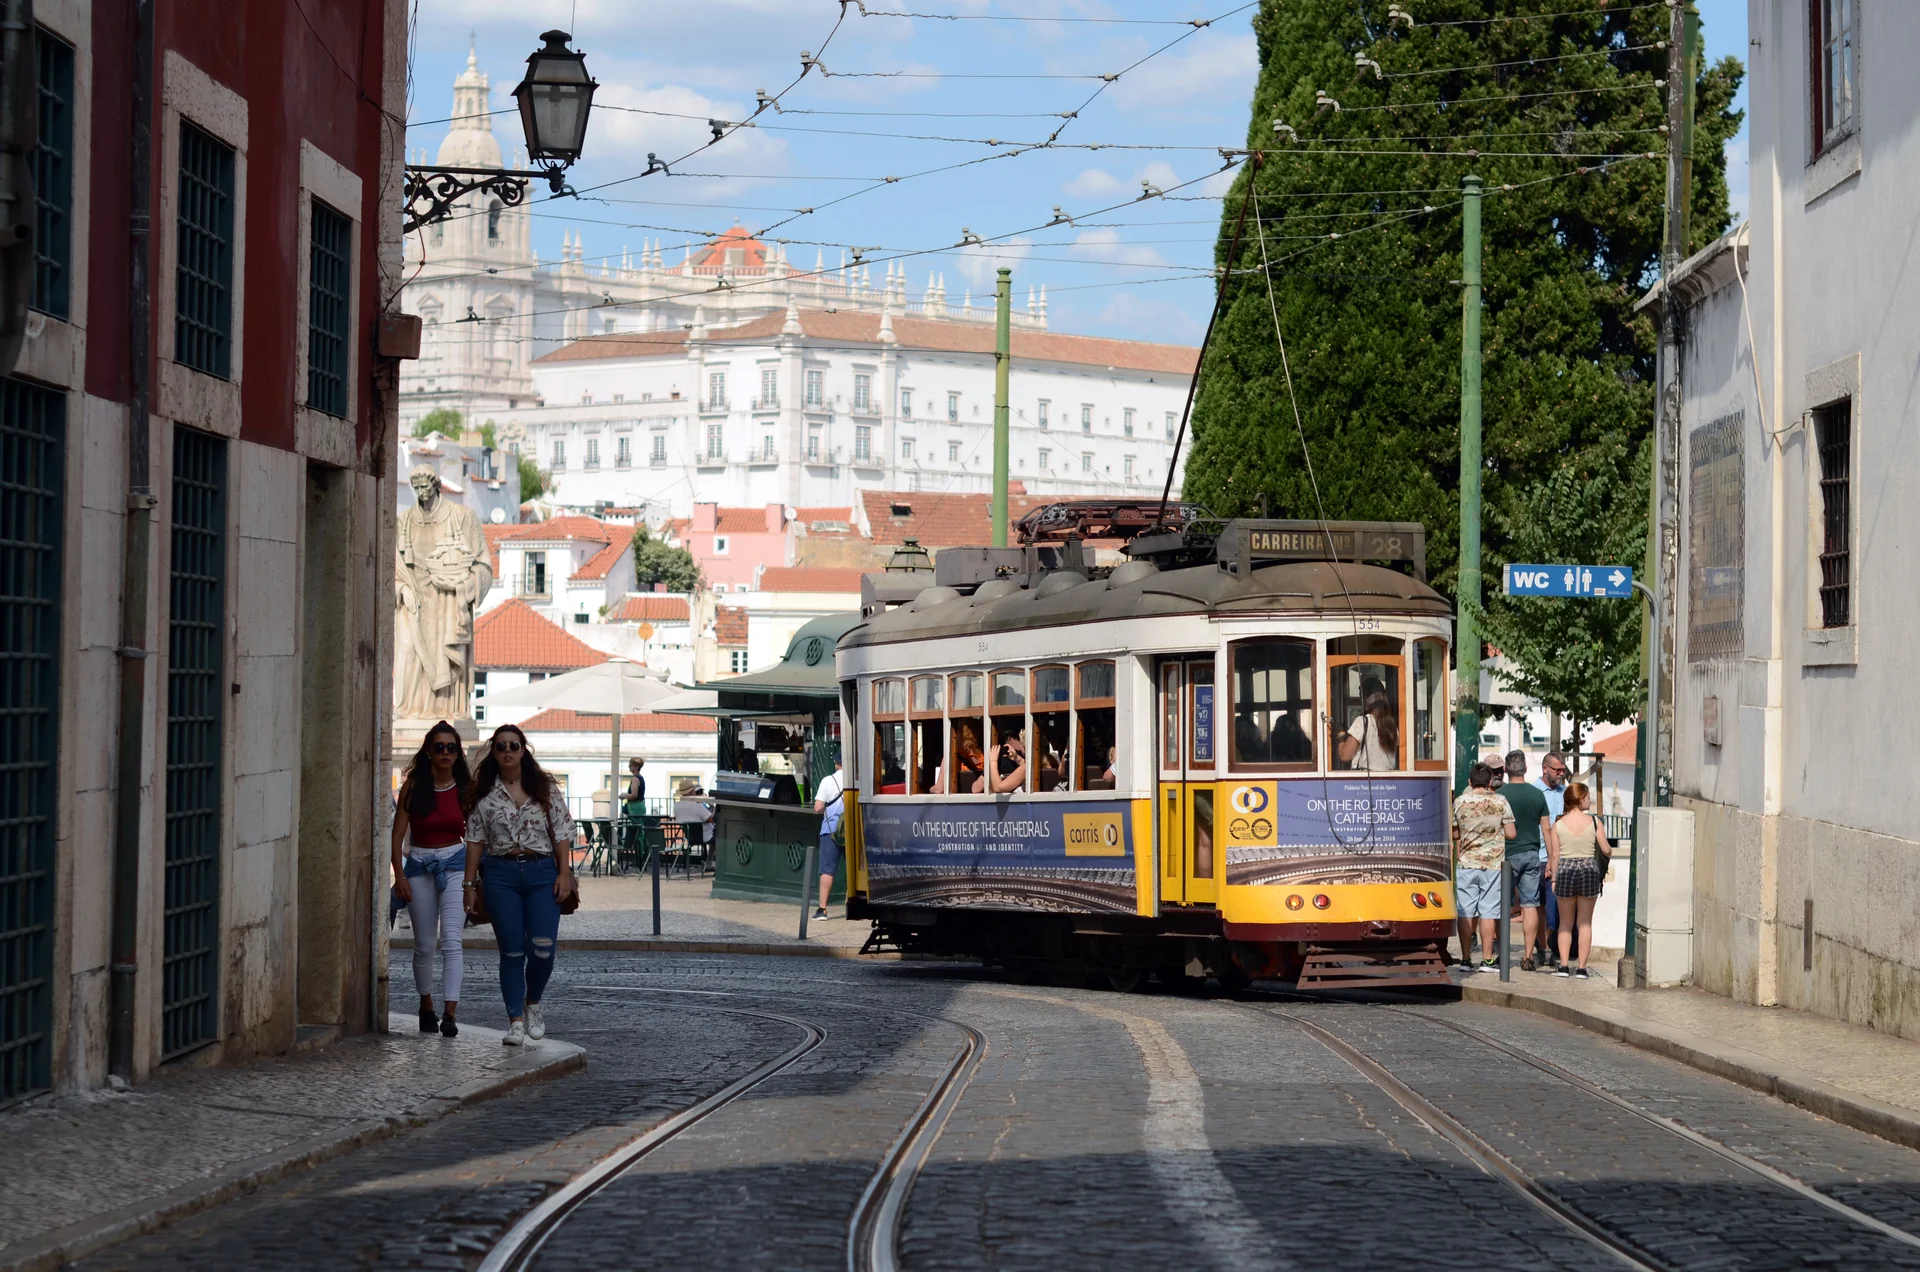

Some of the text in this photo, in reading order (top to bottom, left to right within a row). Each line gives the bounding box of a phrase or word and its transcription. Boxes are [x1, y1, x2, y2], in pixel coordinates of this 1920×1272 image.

[1251, 532, 1324, 551] CARREIRA
[1371, 537, 1402, 558] 28
[1513, 571, 1550, 589] WC
[1359, 619, 1380, 630] 554
[1307, 798, 1423, 811] ON THE ROUTE OF THE
[1334, 811, 1405, 824] CATHEDRALS
[912, 820, 1050, 838] ON THE ROUTE OF THE CATHEDRALS
[1069, 822, 1099, 843] carris
[938, 843, 975, 851] CONSTRUTION
[998, 843, 1024, 851] IDENTITY
